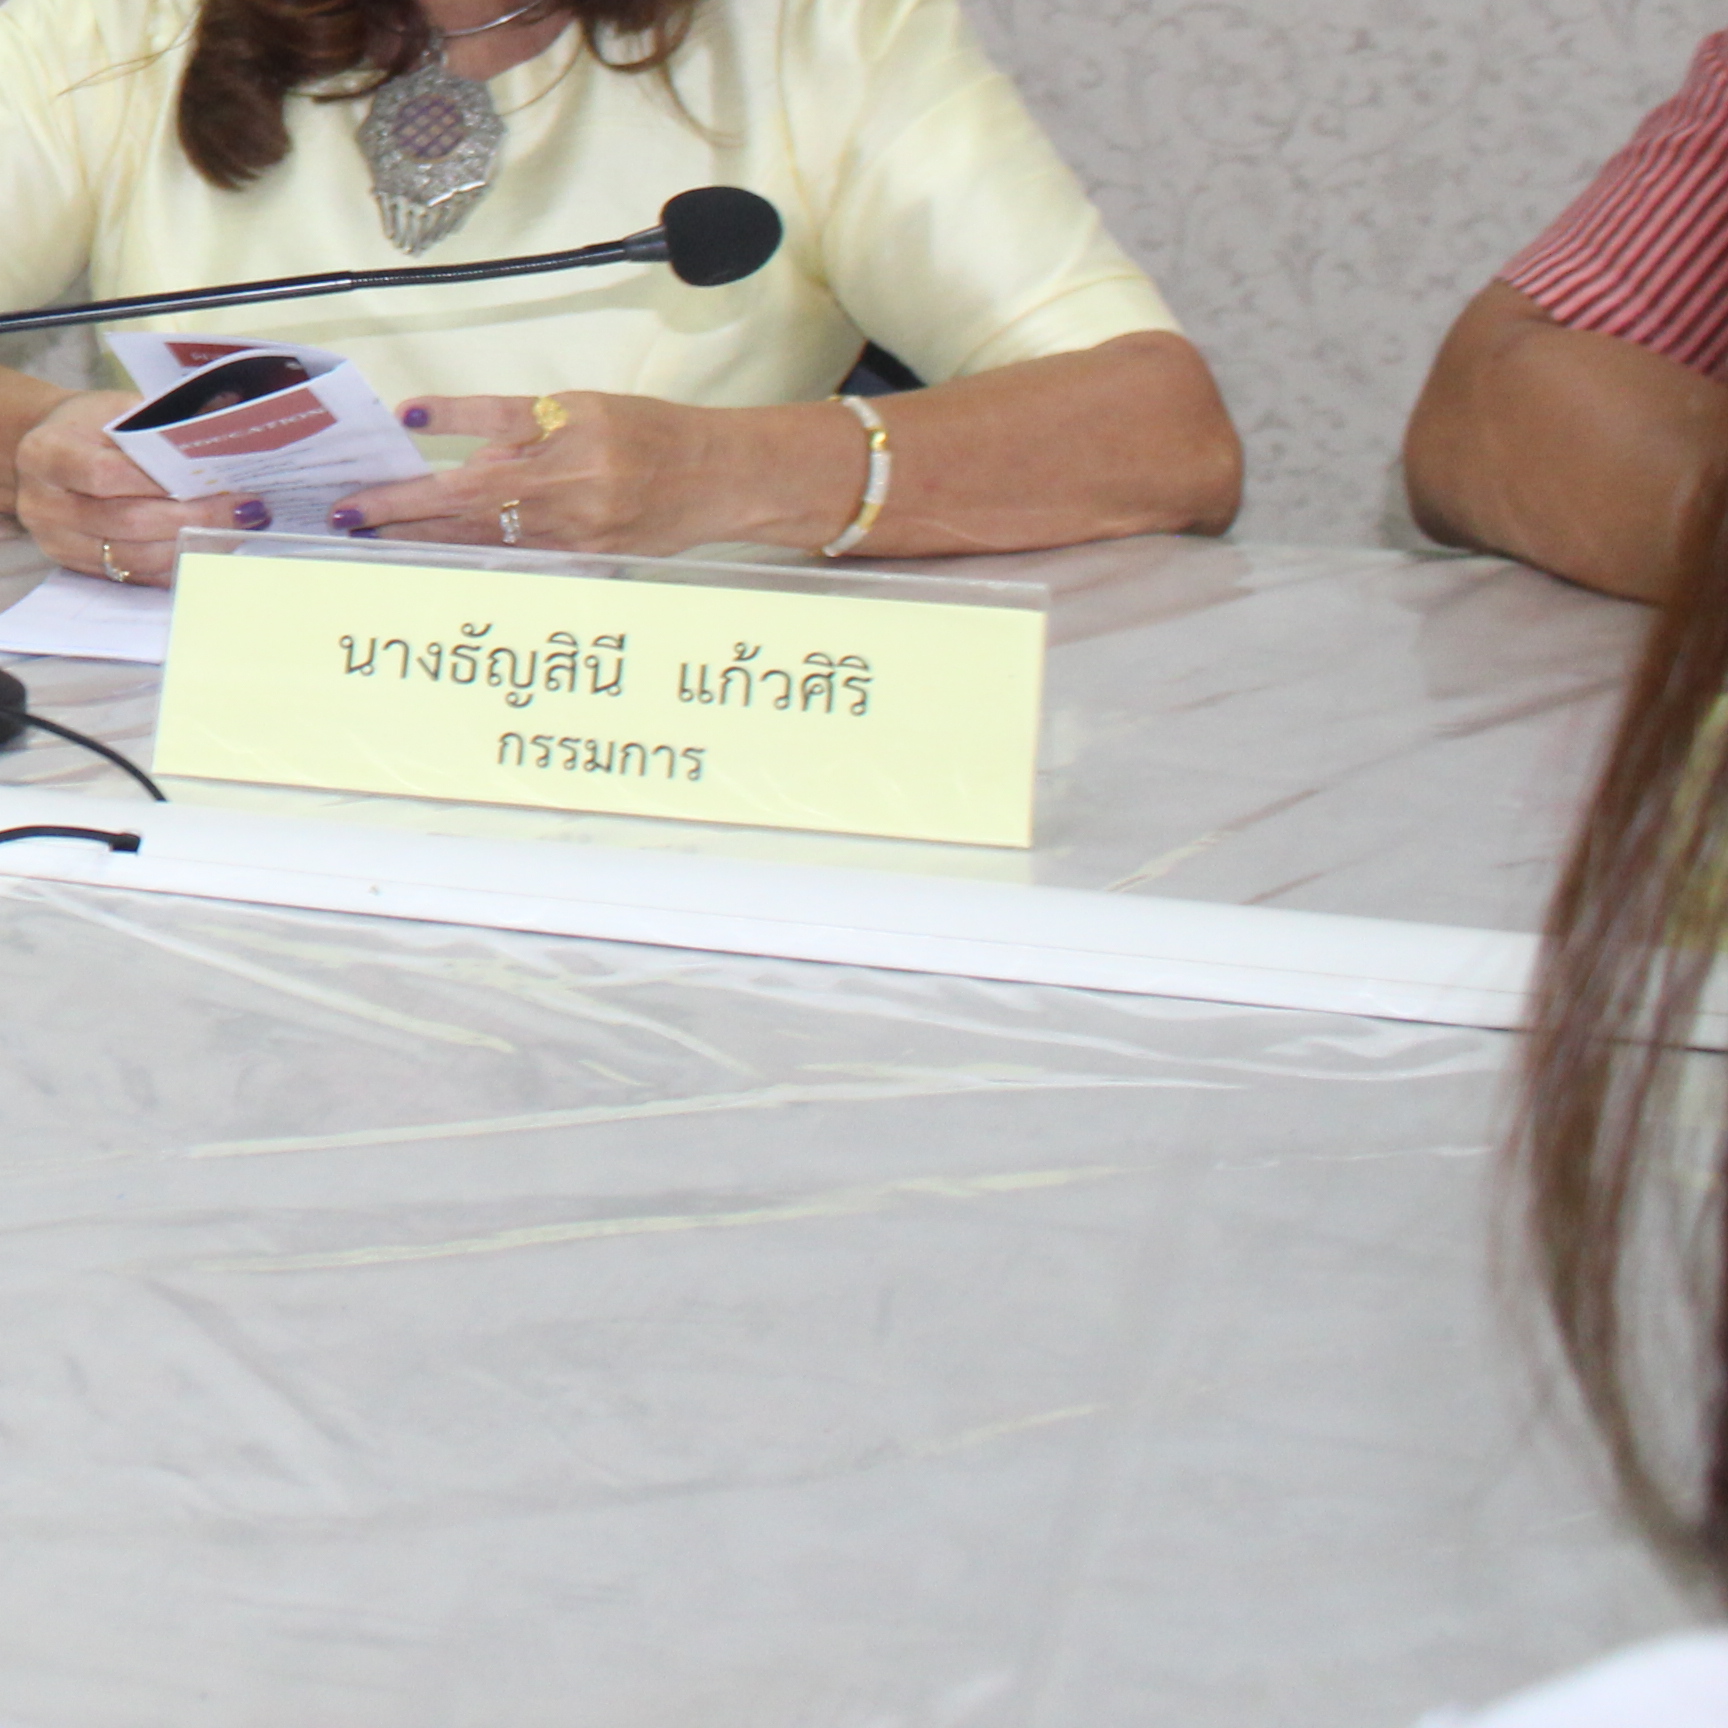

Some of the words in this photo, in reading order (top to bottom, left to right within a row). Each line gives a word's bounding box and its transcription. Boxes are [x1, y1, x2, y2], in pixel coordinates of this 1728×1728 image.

[338, 621, 627, 709] นางธัญสินี
[676, 640, 874, 717] แก้วศิริ
[497, 730, 707, 782] กรรมการ
